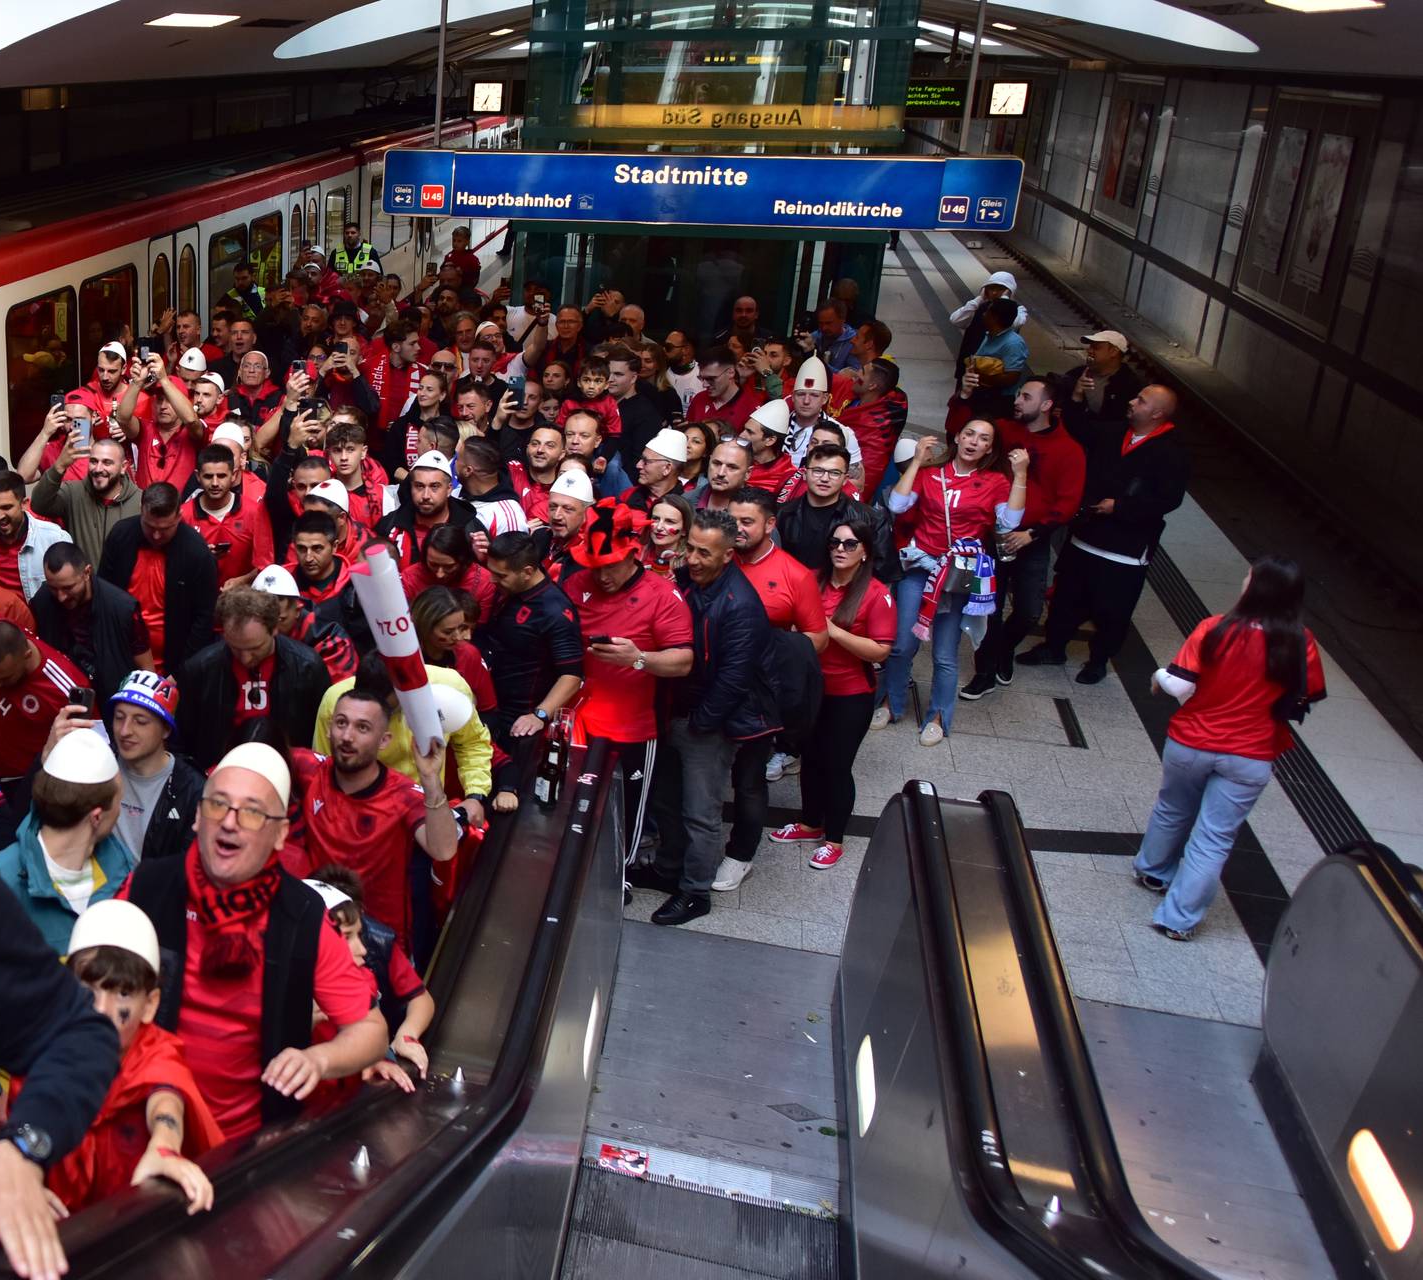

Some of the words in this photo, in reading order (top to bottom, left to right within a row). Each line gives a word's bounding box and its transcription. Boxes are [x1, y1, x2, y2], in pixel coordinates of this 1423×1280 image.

[614, 163, 748, 186] Stadtmitte
[394, 186, 412, 194] Gleis
[430, 193, 442, 201] 45
[404, 196, 411, 204] 2
[456, 191, 573, 209] Hauptbahnhof
[981, 199, 1003, 208] Gleis
[773, 199, 903, 217] Reinoldikirche
[941, 204, 950, 213] U
[952, 205, 965, 214] 46
[978, 208, 985, 220] 1
[375, 615, 410, 638] 024
[126, 673, 171, 700] ALIA
[241, 680, 268, 710] 15
